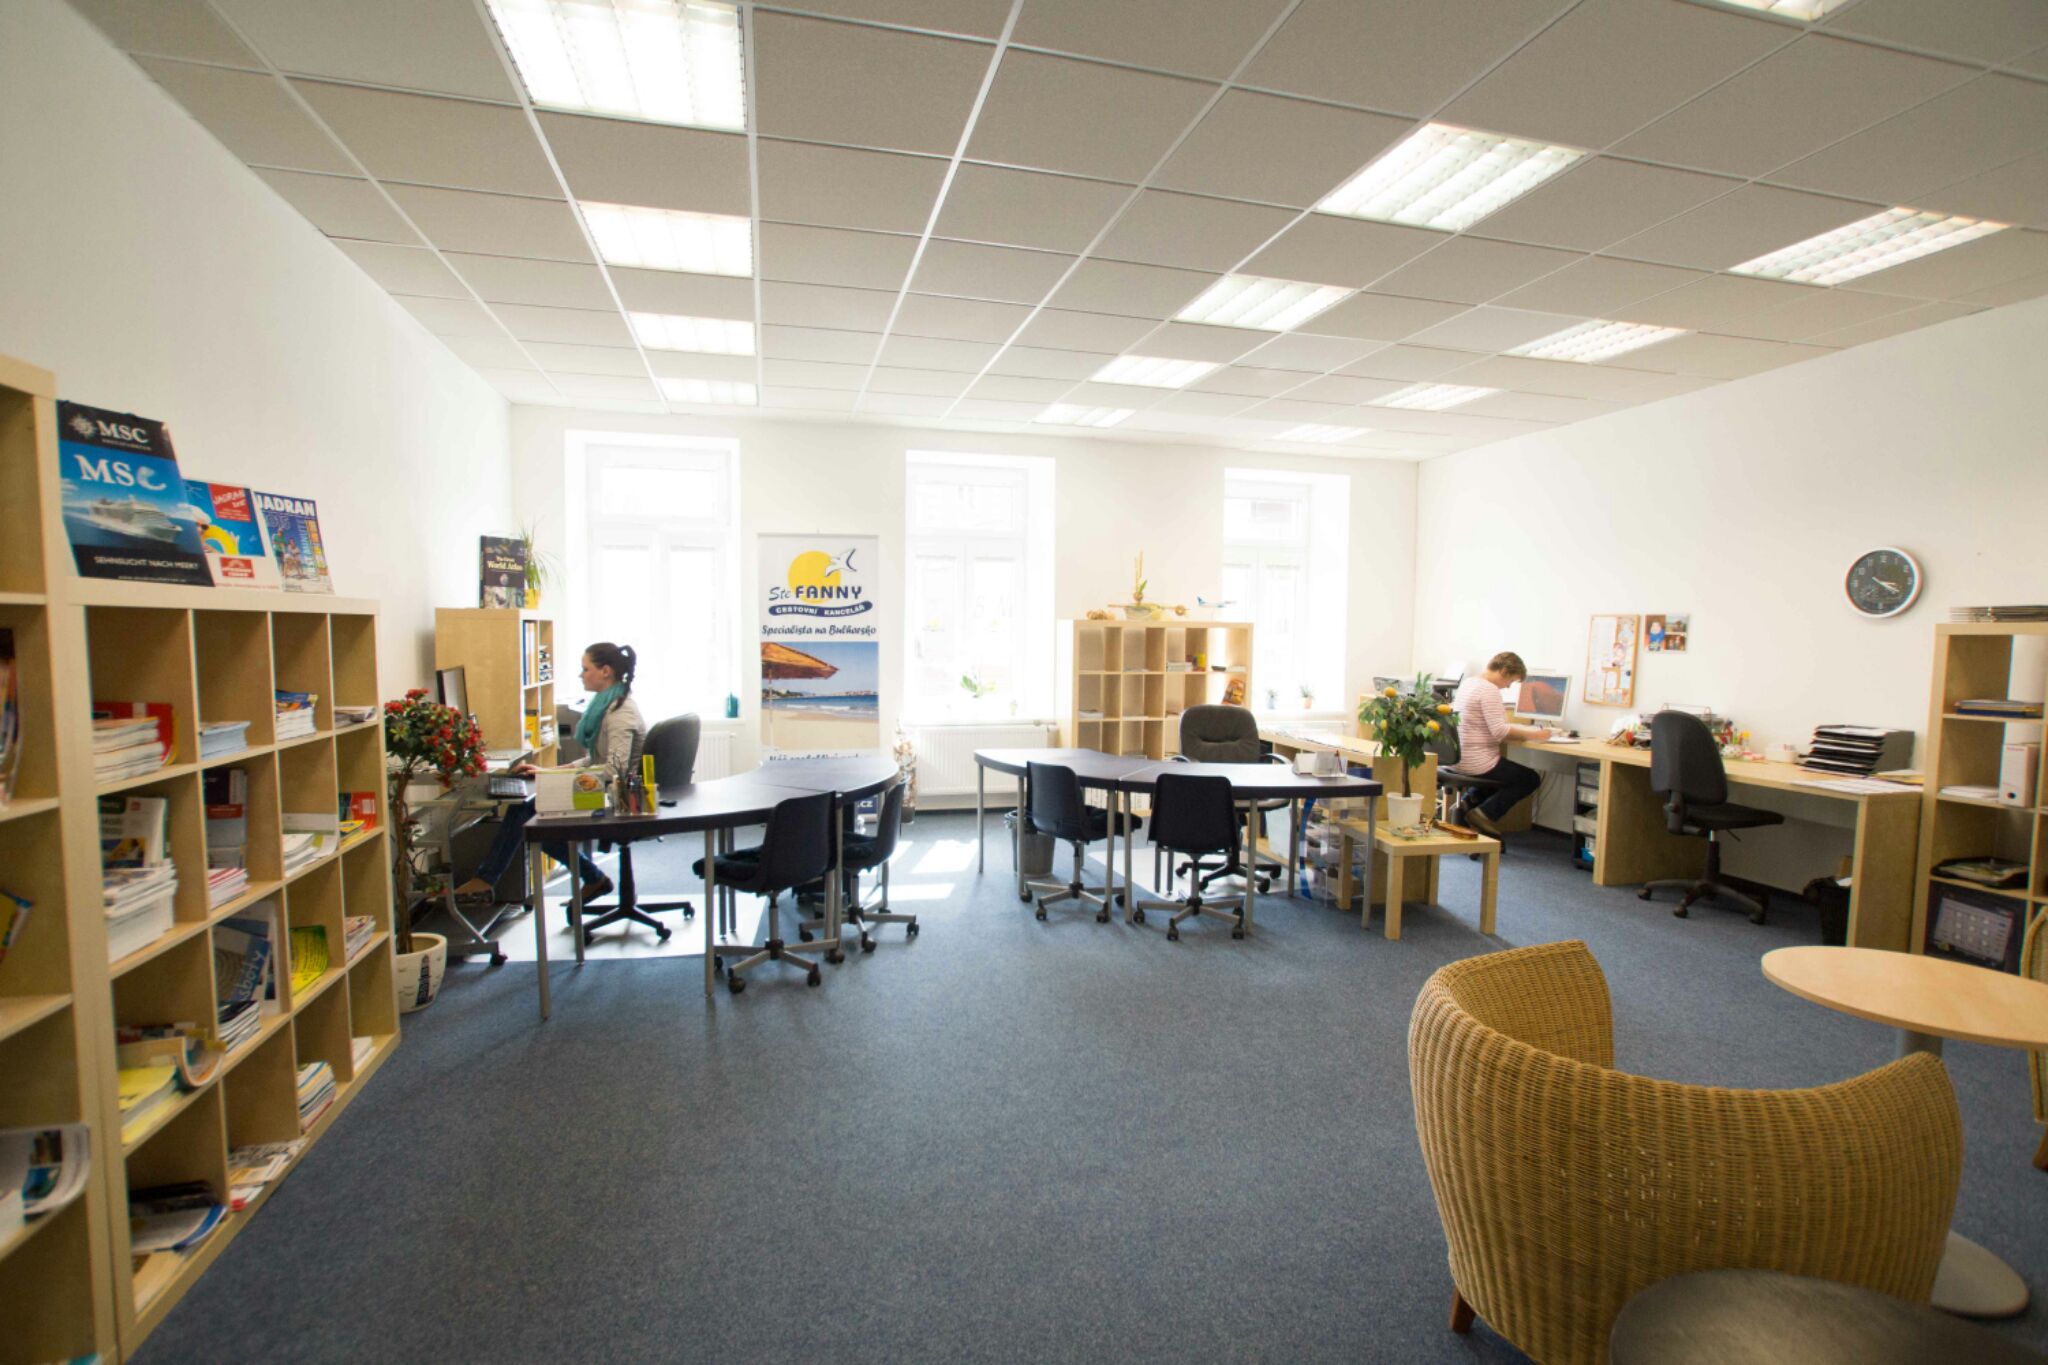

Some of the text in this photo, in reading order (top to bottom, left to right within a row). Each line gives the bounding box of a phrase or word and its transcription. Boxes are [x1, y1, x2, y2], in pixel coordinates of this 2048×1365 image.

[96, 420, 149, 443] MSC
[74, 454, 167, 490] MSC
[255, 494, 315, 516] JADRAN
[795, 585, 862, 599] FANNY
[815, 627, 827, 635] na
